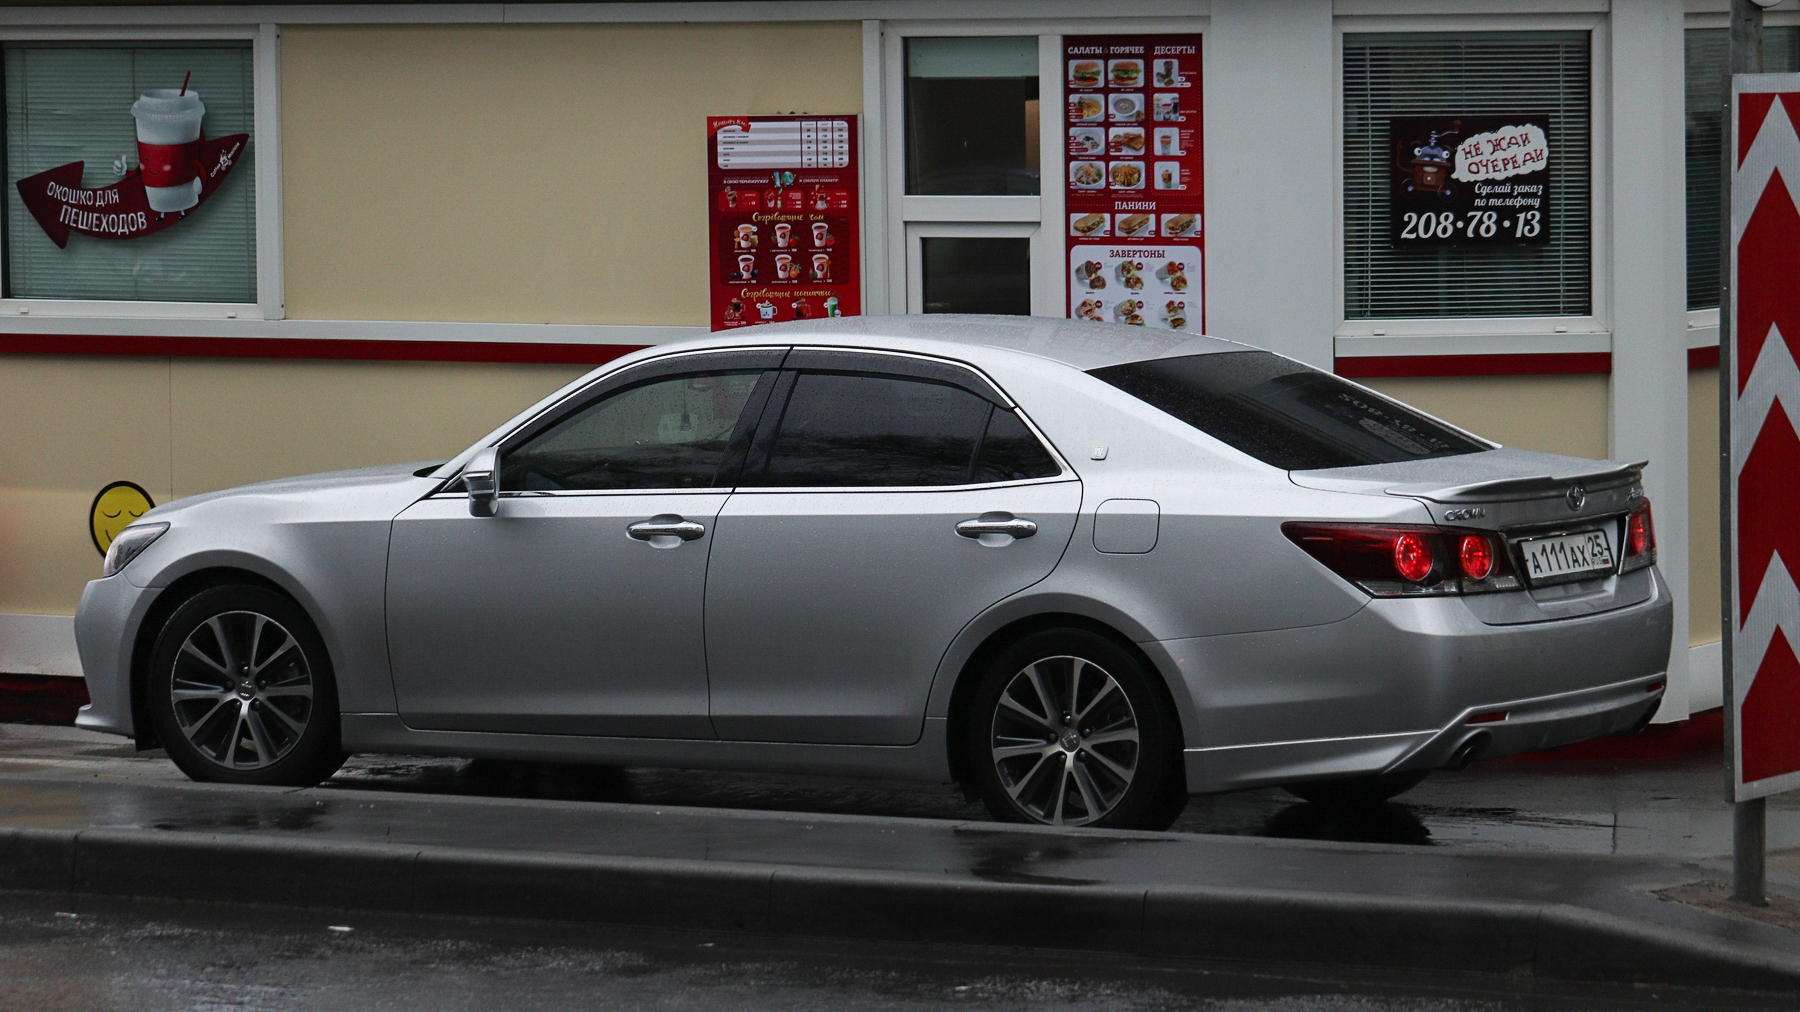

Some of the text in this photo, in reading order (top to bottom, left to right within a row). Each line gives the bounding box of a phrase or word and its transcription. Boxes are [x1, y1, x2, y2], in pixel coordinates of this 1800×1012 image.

[1067, 45, 1103, 54] САЛАТЫ
[1109, 45, 1145, 54] ГОРЯЧЕЕ
[1154, 45, 1196, 55] ДЕСЕРТЫ
[1461, 133, 1531, 160] НЕ ЖДИ
[1467, 148, 1545, 175] ОЧЕРЕДИ
[47, 181, 120, 208] ОКОШКО ДЛЯ
[1475, 182, 1543, 196] Сделай заказ
[1114, 201, 1156, 210] ПАНИНИ
[1474, 195, 1541, 209] по телефону
[60, 204, 148, 236] ПЕШЕХОДОВ
[1109, 249, 1165, 259] ЗАВЕРТОНЫ
[1444, 507, 1486, 522] CROWN
[1588, 535, 1605, 558] 25
[1592, 558, 1603, 566] RUS
